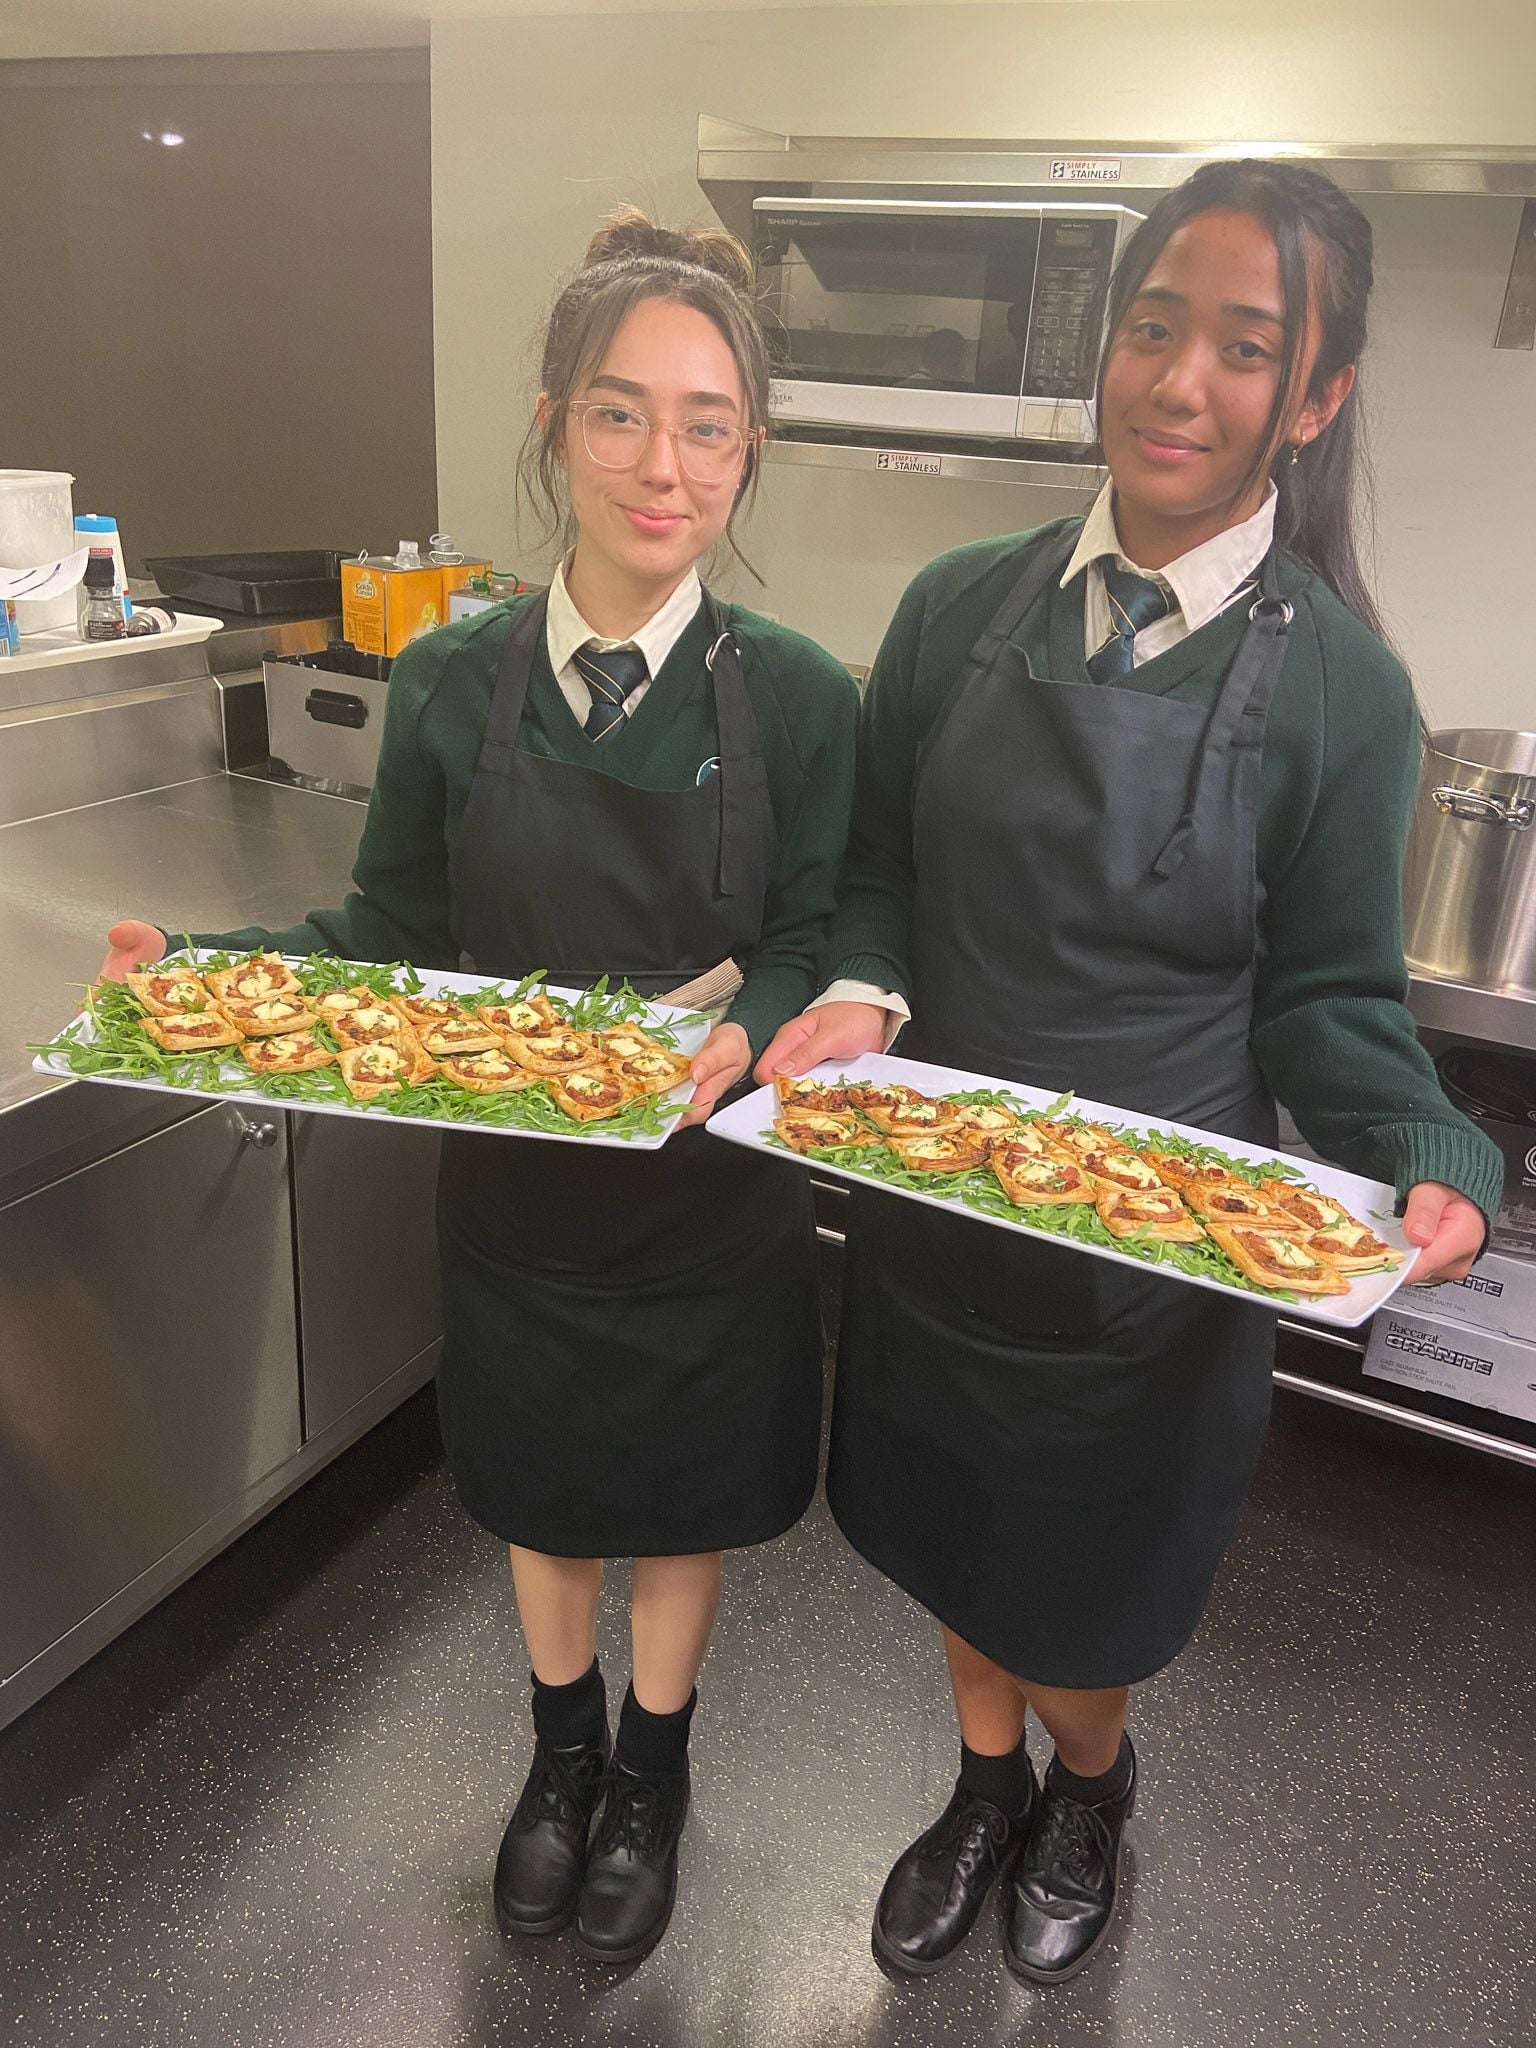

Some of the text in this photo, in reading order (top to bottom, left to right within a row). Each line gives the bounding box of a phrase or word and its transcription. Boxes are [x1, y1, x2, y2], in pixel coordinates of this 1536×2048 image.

[1071, 170, 1119, 179] STAINLESS
[890, 454, 919, 463] SIMPLY
[895, 461, 939, 473] STAINLESS
[1388, 1321, 1439, 1344] Baccarat
[1385, 1333, 1494, 1376] GRANITE
